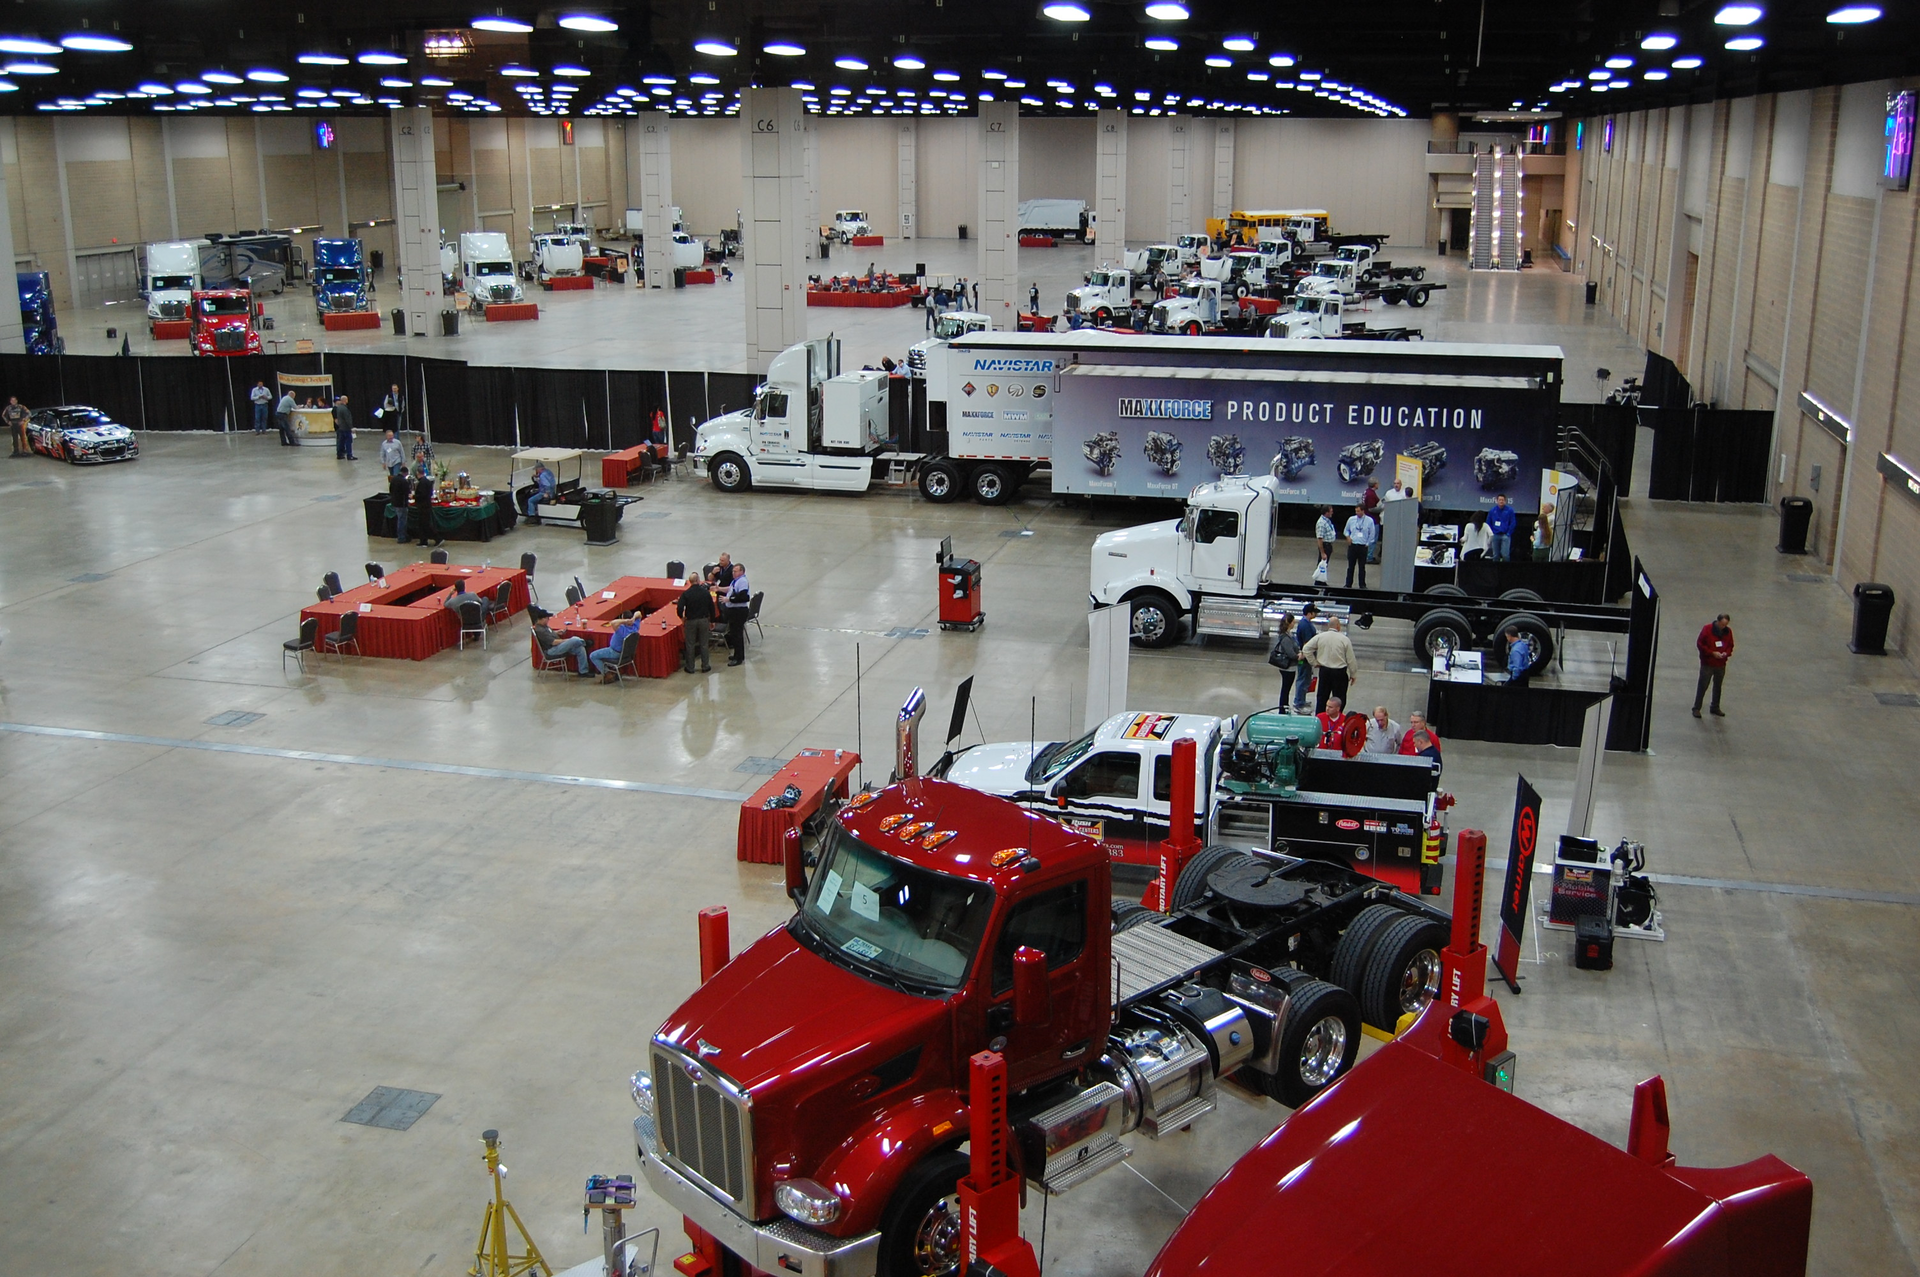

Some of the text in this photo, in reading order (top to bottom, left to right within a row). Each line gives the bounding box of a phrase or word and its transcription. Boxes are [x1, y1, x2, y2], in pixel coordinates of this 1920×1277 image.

[401, 126, 412, 134] C2
[758, 120, 774, 131] C6
[990, 122, 1002, 131] C7
[973, 359, 1053, 372] NAVISTAR
[1119, 398, 1482, 430] MAXXFORCE PRODUCT EDUCATION
[42, 431, 53, 449] 14
[1512, 806, 1536, 914] Warner
[1557, 888, 1597, 898] Service
[1452, 968, 1462, 992] LIFT
[969, 1205, 977, 1235] LIFT
